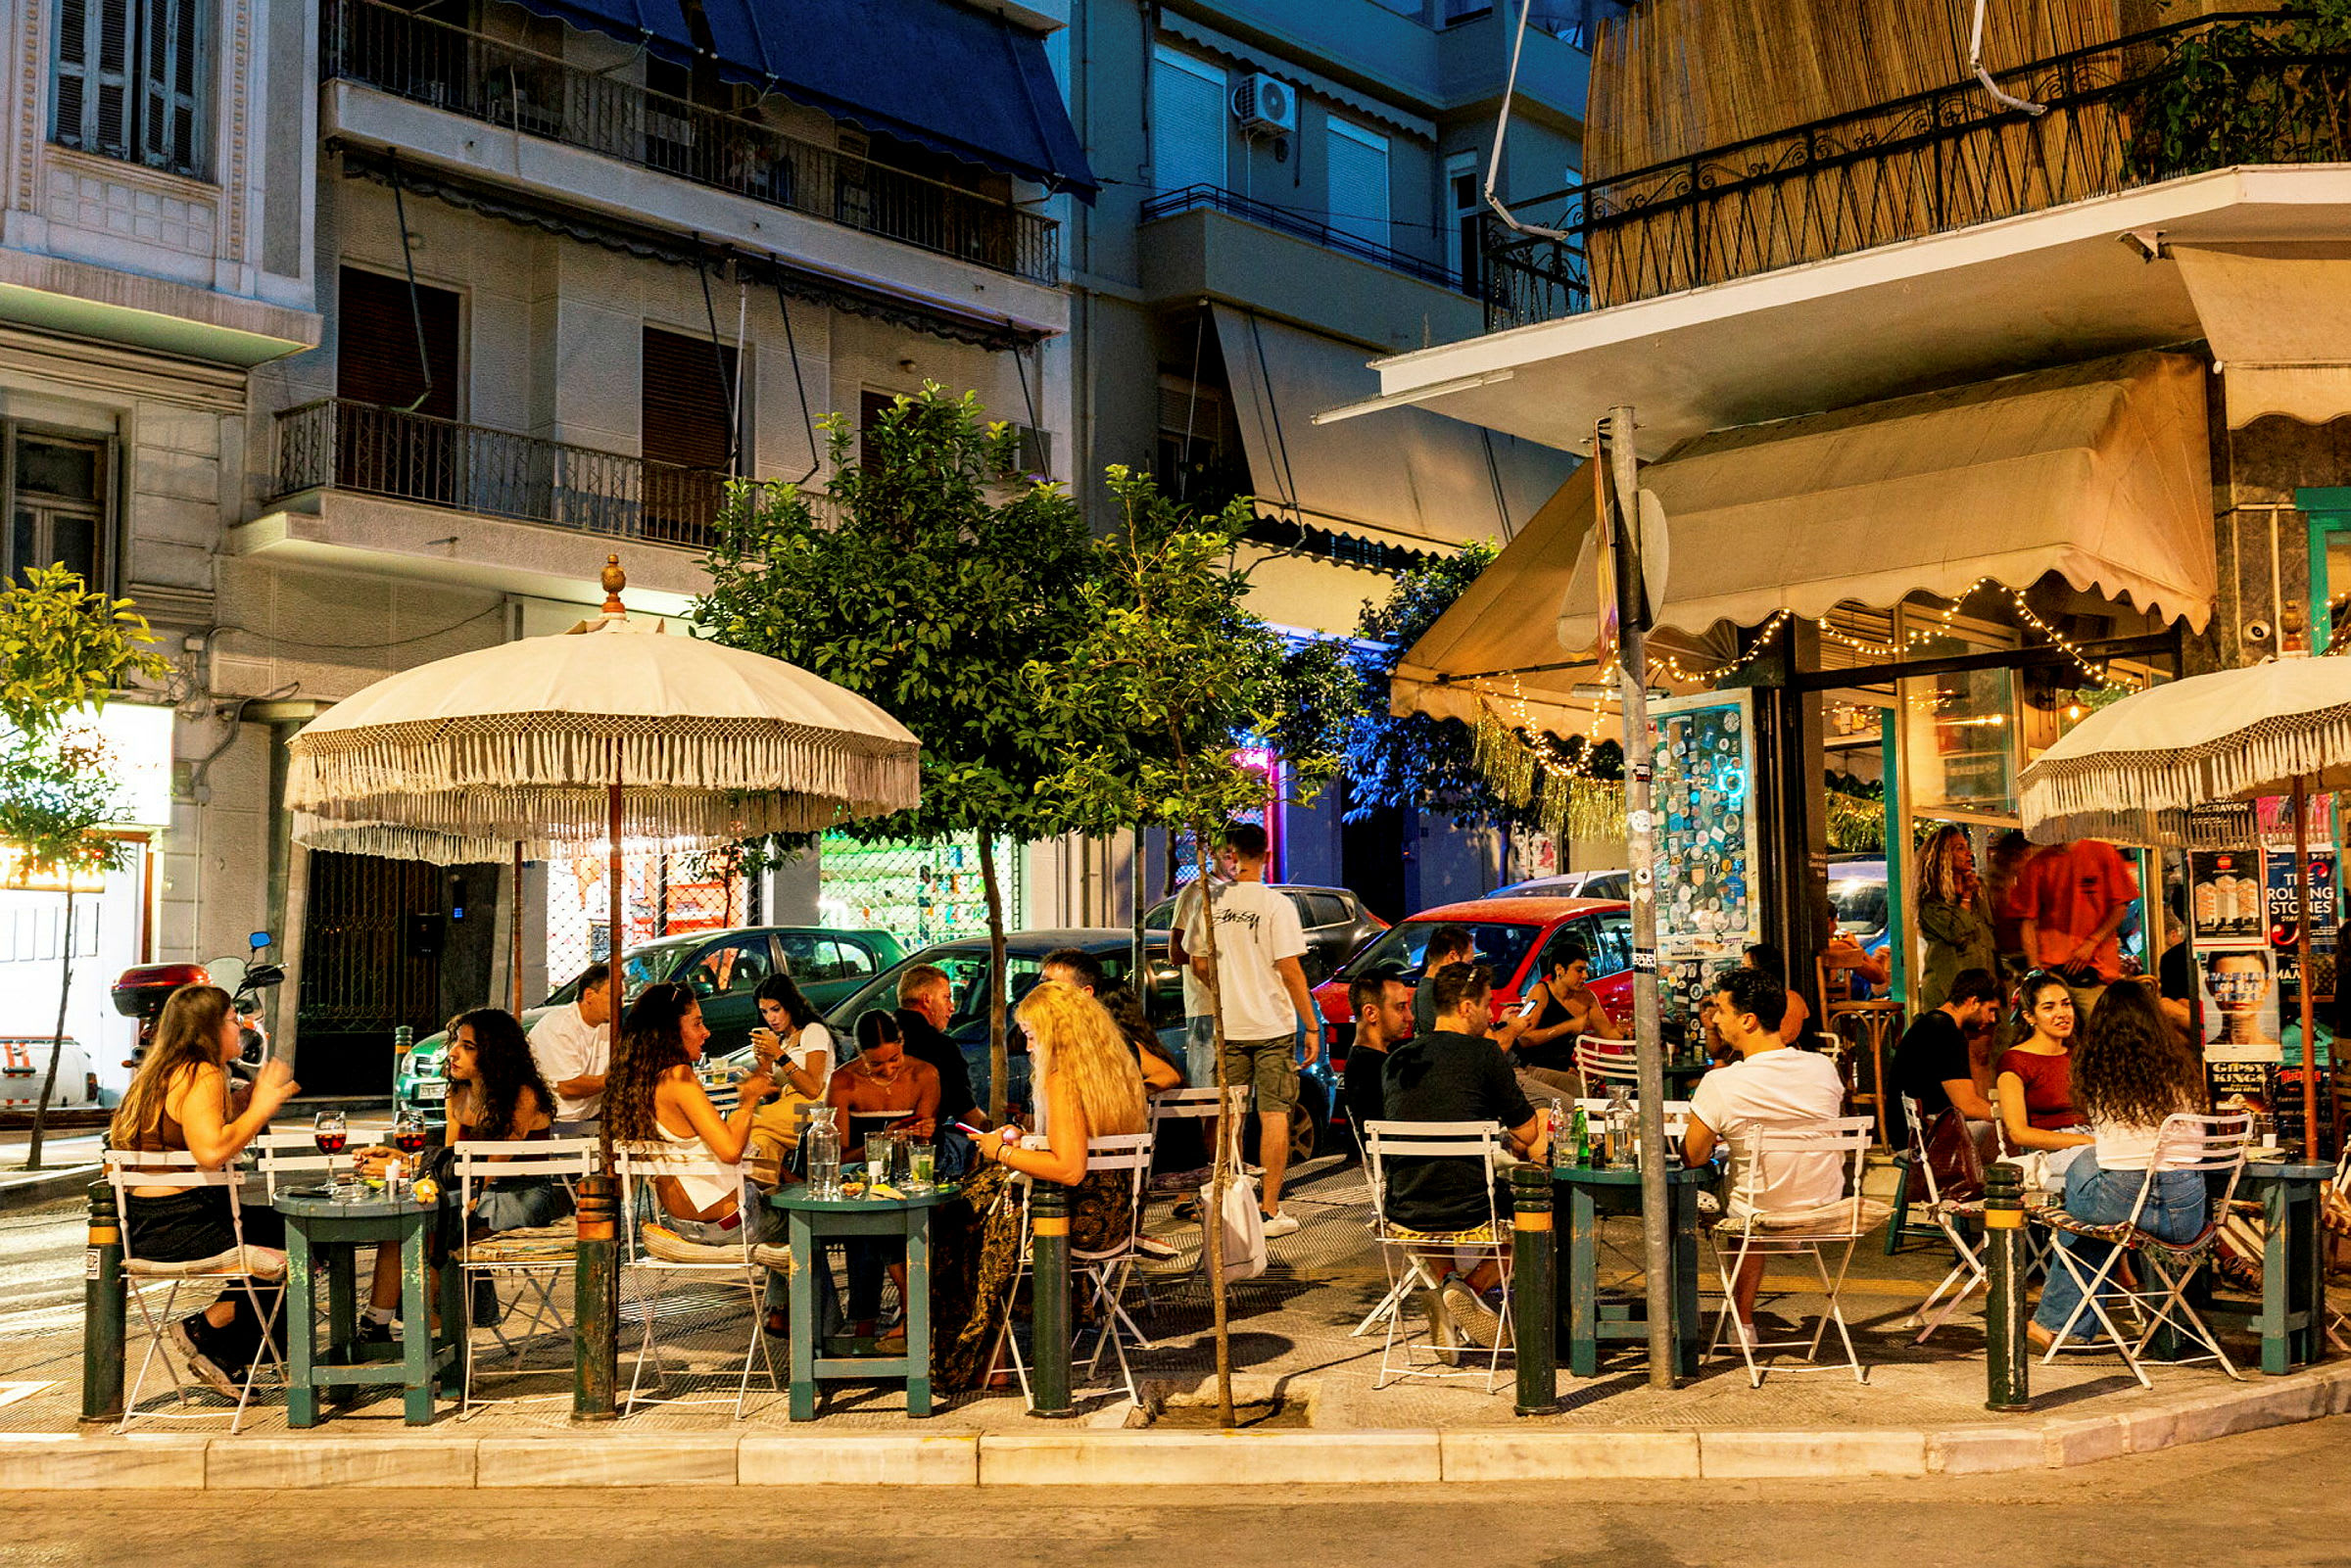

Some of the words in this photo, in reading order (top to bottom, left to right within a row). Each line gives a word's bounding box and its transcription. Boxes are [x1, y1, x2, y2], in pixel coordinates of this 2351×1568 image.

[2283, 873, 2316, 886] TE
[2267, 886, 2335, 900] ROLNG
[2213, 1063, 2266, 1072] GIPSY
[2213, 1073, 2268, 1083] KINGS
